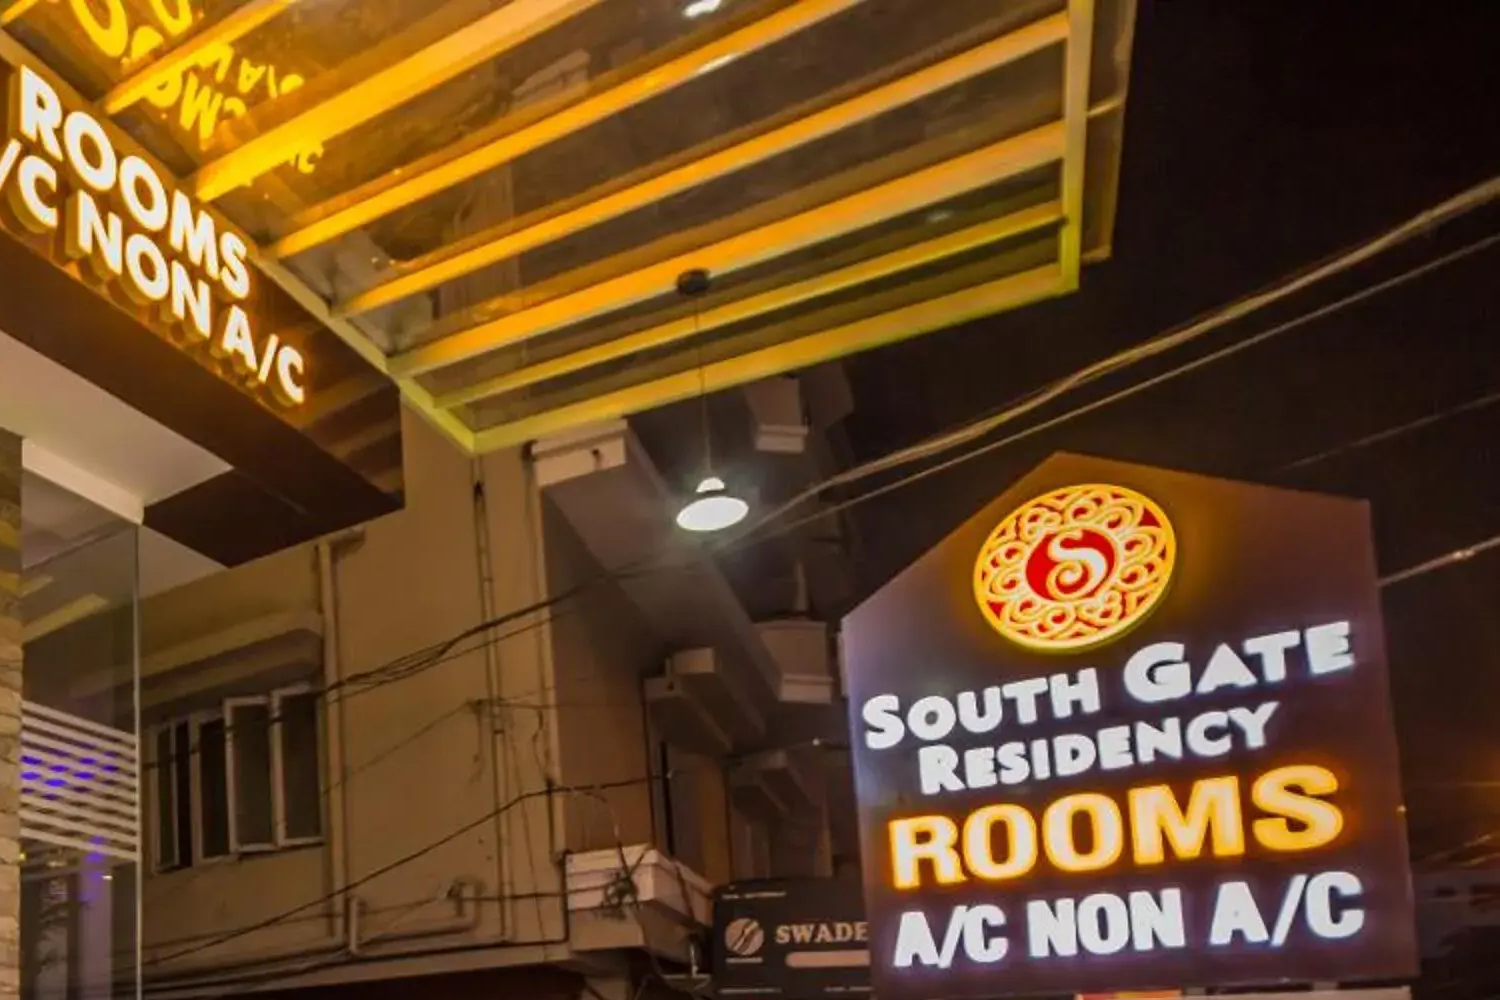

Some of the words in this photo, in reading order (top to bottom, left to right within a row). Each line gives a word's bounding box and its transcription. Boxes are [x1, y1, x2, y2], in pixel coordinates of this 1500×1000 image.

[19, 64, 251, 300] ROOMS
[76, 188, 211, 339] NON
[221, 303, 305, 405] A/C
[861, 667, 1101, 750] SOUTH
[1122, 621, 1356, 704] GATE
[917, 701, 1280, 795] RESIDENCY
[887, 764, 1345, 890] ROOMS
[893, 903, 1010, 969] A/C
[1026, 888, 1186, 959] NON
[1209, 871, 1365, 948] A/C
